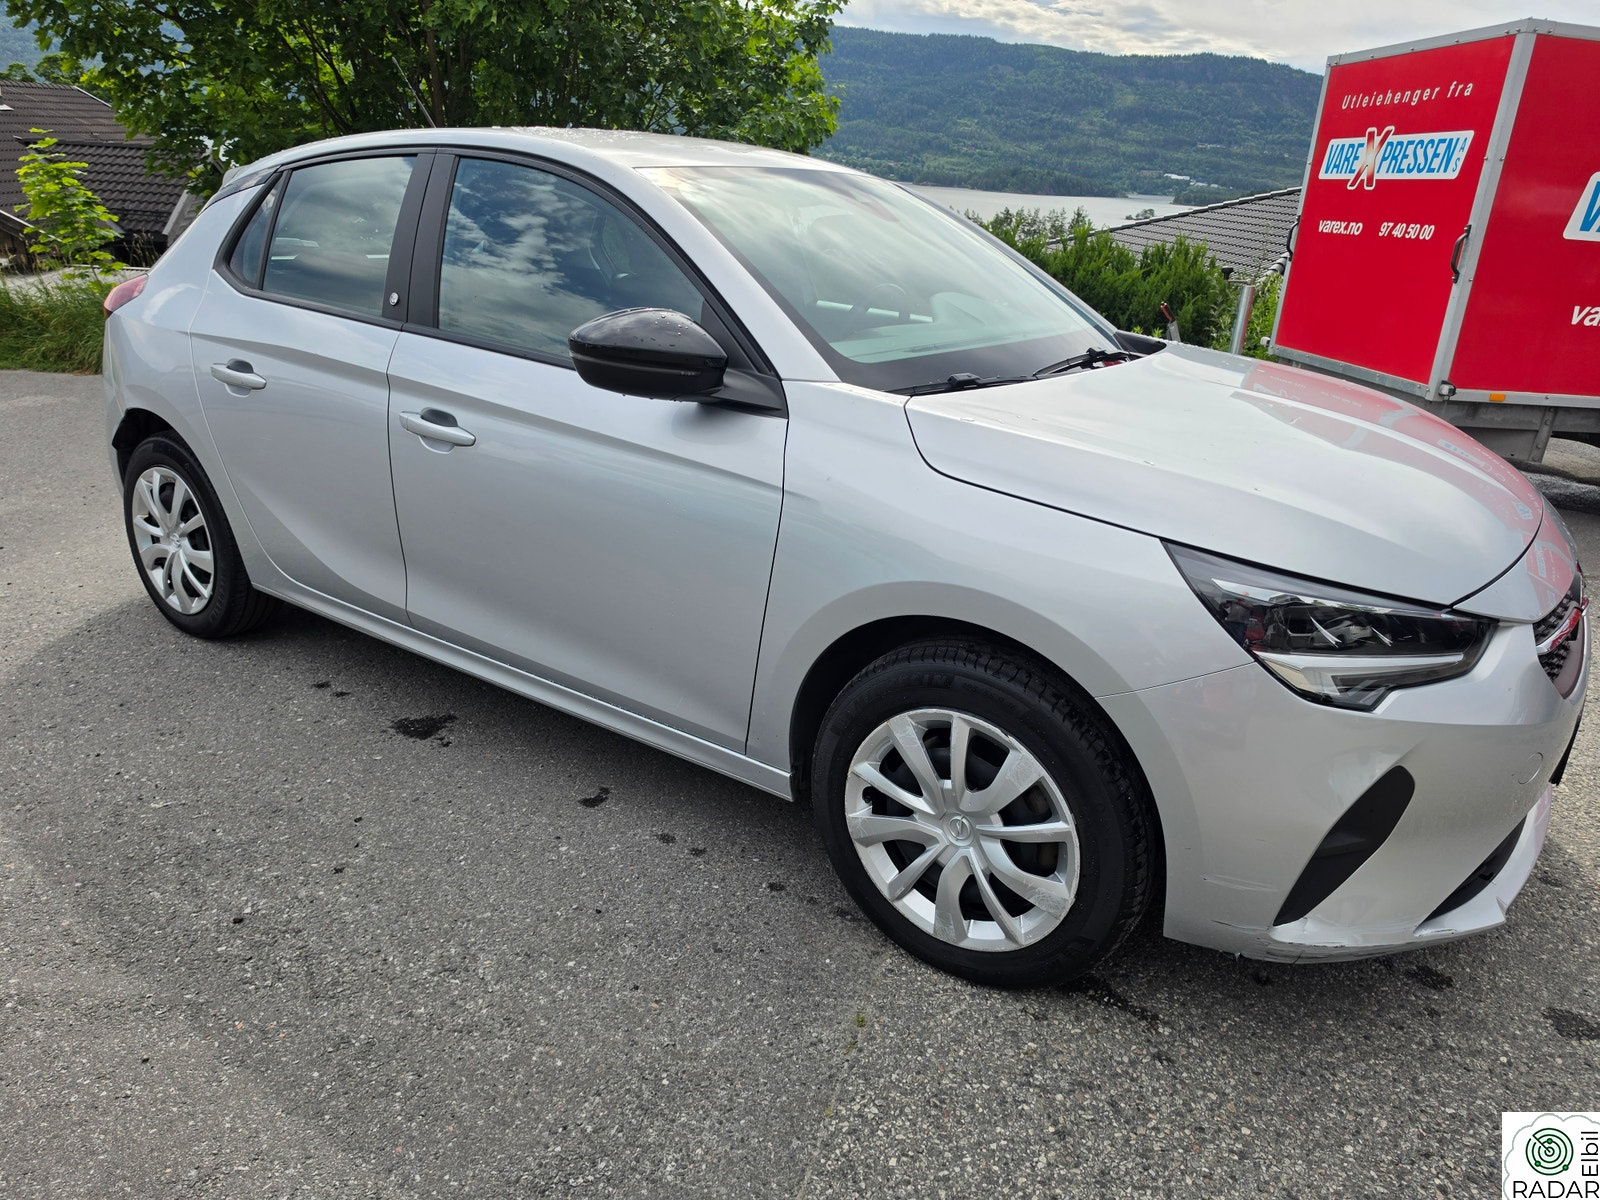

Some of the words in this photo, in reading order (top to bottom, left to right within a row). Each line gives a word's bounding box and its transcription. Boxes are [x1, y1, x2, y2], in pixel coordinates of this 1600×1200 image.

[1341, 86, 1440, 110] Utleiehenger
[1447, 80, 1474, 98] fra
[1324, 126, 1461, 189] VAREXPRESSEN
[1318, 219, 1363, 236] varex.no
